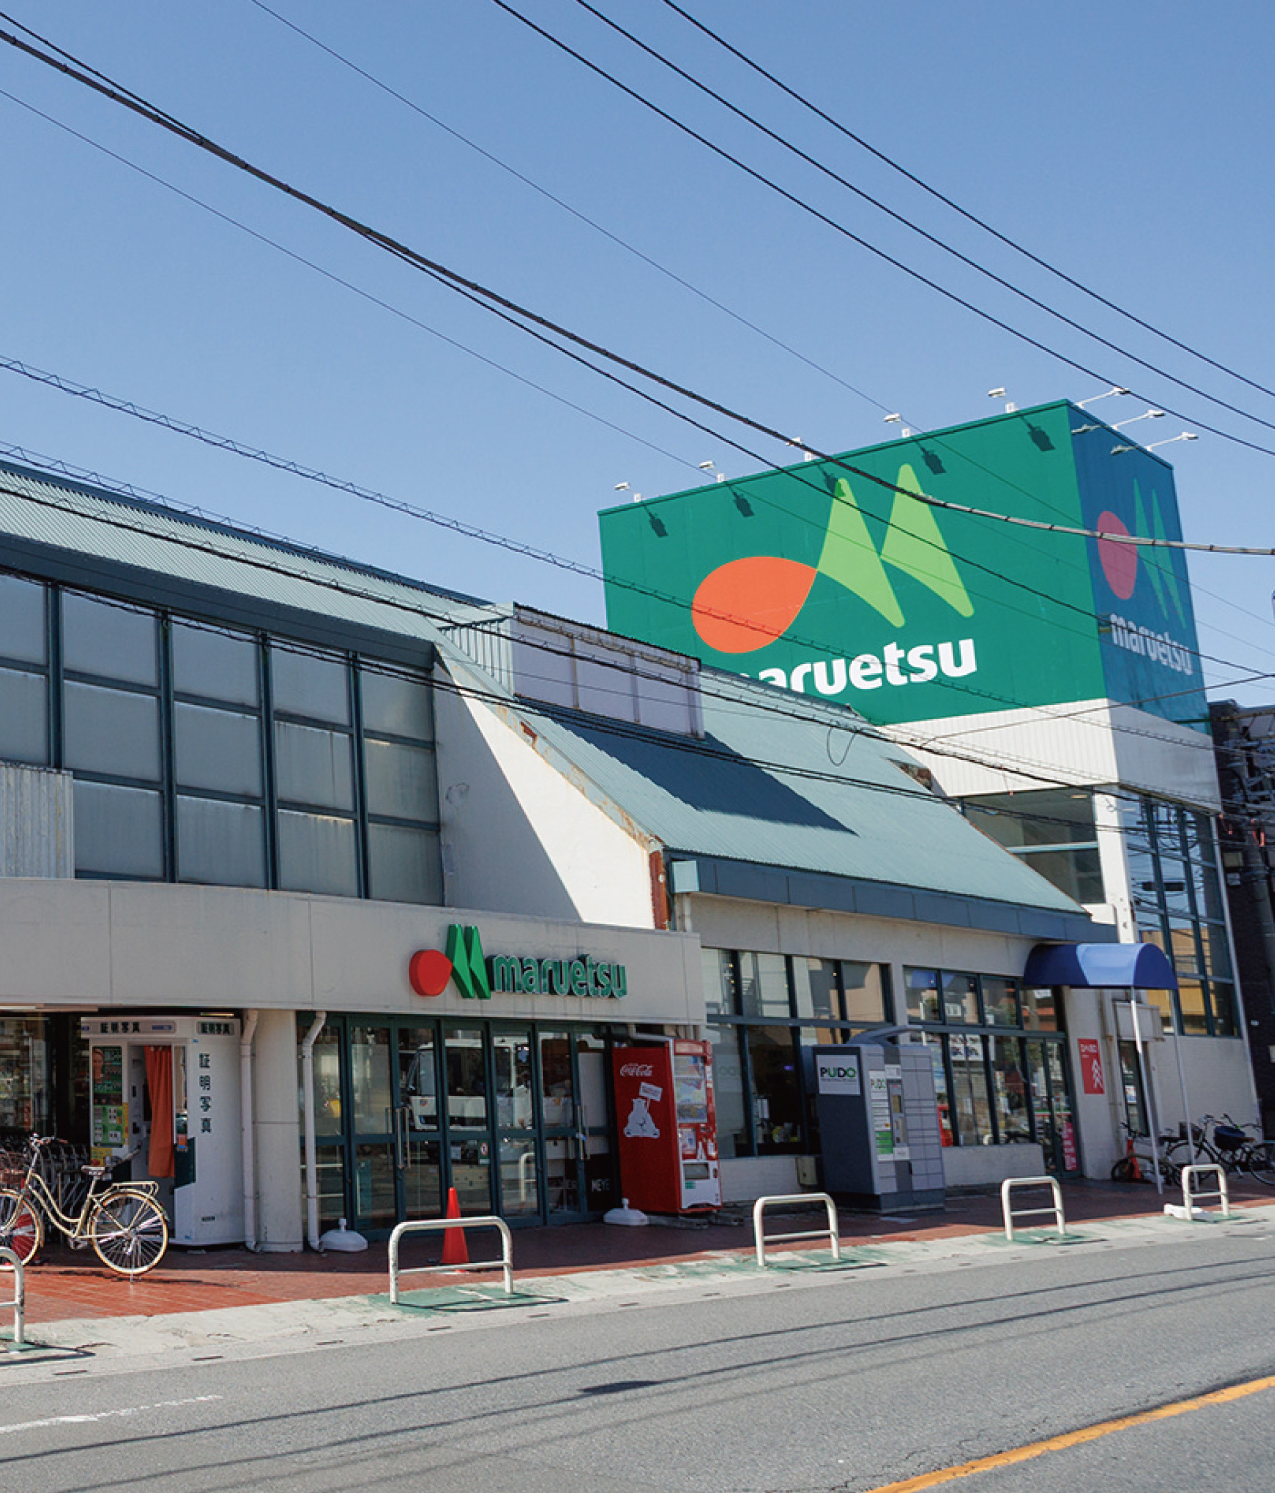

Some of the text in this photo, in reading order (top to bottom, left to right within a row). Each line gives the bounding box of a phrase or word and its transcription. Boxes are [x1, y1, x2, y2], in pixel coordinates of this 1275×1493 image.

[739, 638, 978, 696] aruetsu
[1110, 613, 1193, 676] maruetsu
[492, 953, 628, 999] maruetsu
[198, 1052, 212, 1133] 証明写真
[820, 1066, 857, 1078] PUDO
